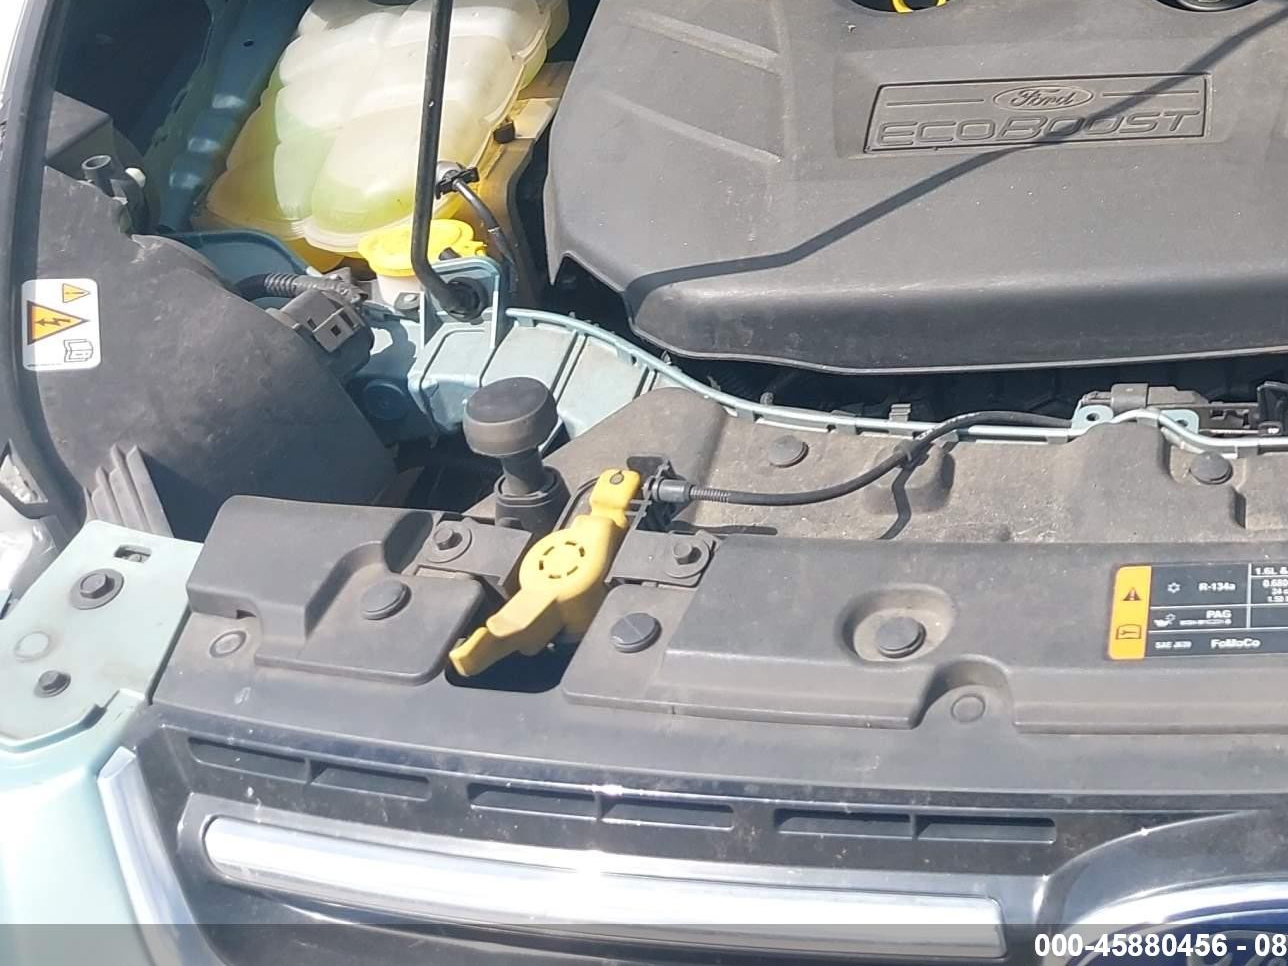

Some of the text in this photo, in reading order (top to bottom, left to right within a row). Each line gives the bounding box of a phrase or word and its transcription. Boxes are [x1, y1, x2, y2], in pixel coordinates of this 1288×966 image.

[1010, 87, 1077, 108] Ford
[876, 109, 1201, 146] ECOBOOST
[1255, 566, 1278, 575] 1.6L
[1198, 582, 1236, 592] R-134a
[1206, 610, 1232, 619] PAG
[1210, 638, 1261, 649] FoMoCo
